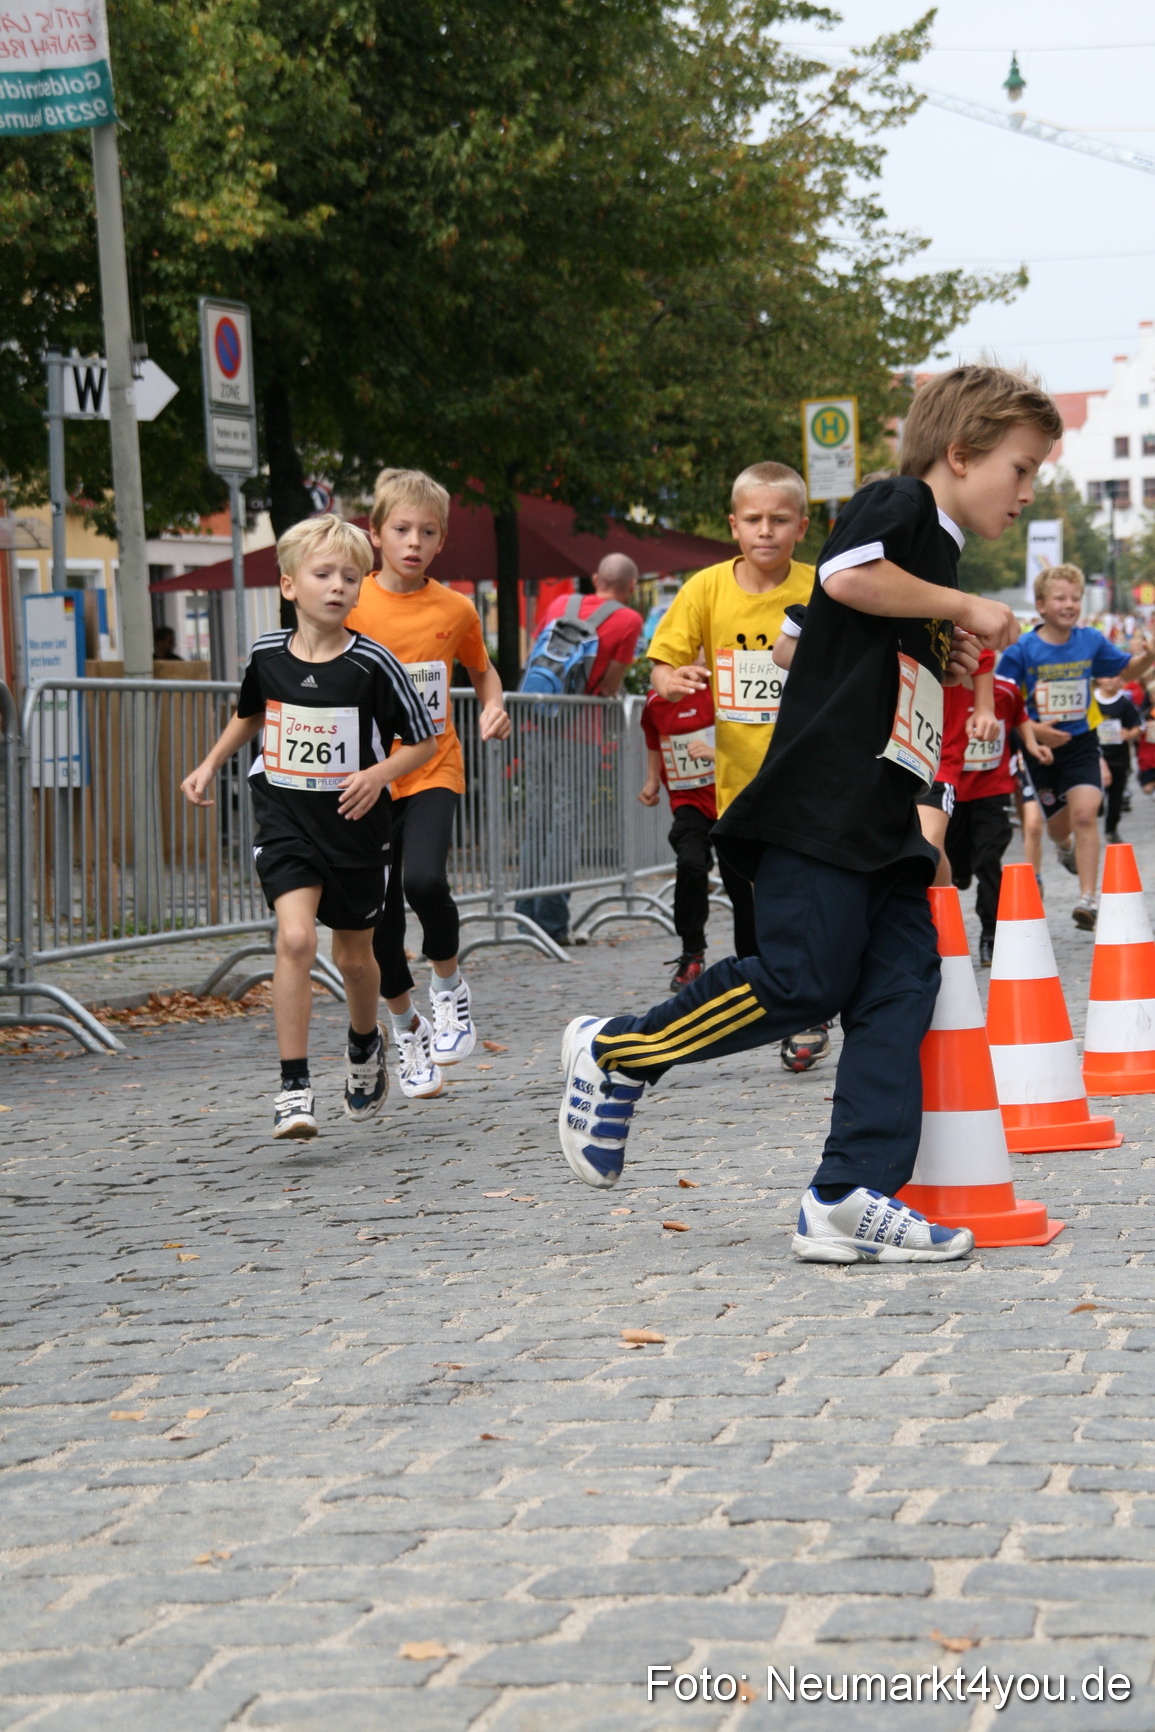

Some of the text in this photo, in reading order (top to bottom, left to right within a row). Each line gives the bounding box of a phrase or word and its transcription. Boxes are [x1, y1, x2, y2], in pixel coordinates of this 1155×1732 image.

[73, 366, 107, 413] W
[220, 384, 241, 400] ZONE
[821, 417, 839, 438] H
[740, 679, 783, 699] 729
[1051, 693, 1083, 707] 7312
[286, 716, 338, 735] Jonas
[286, 739, 347, 764] 7261
